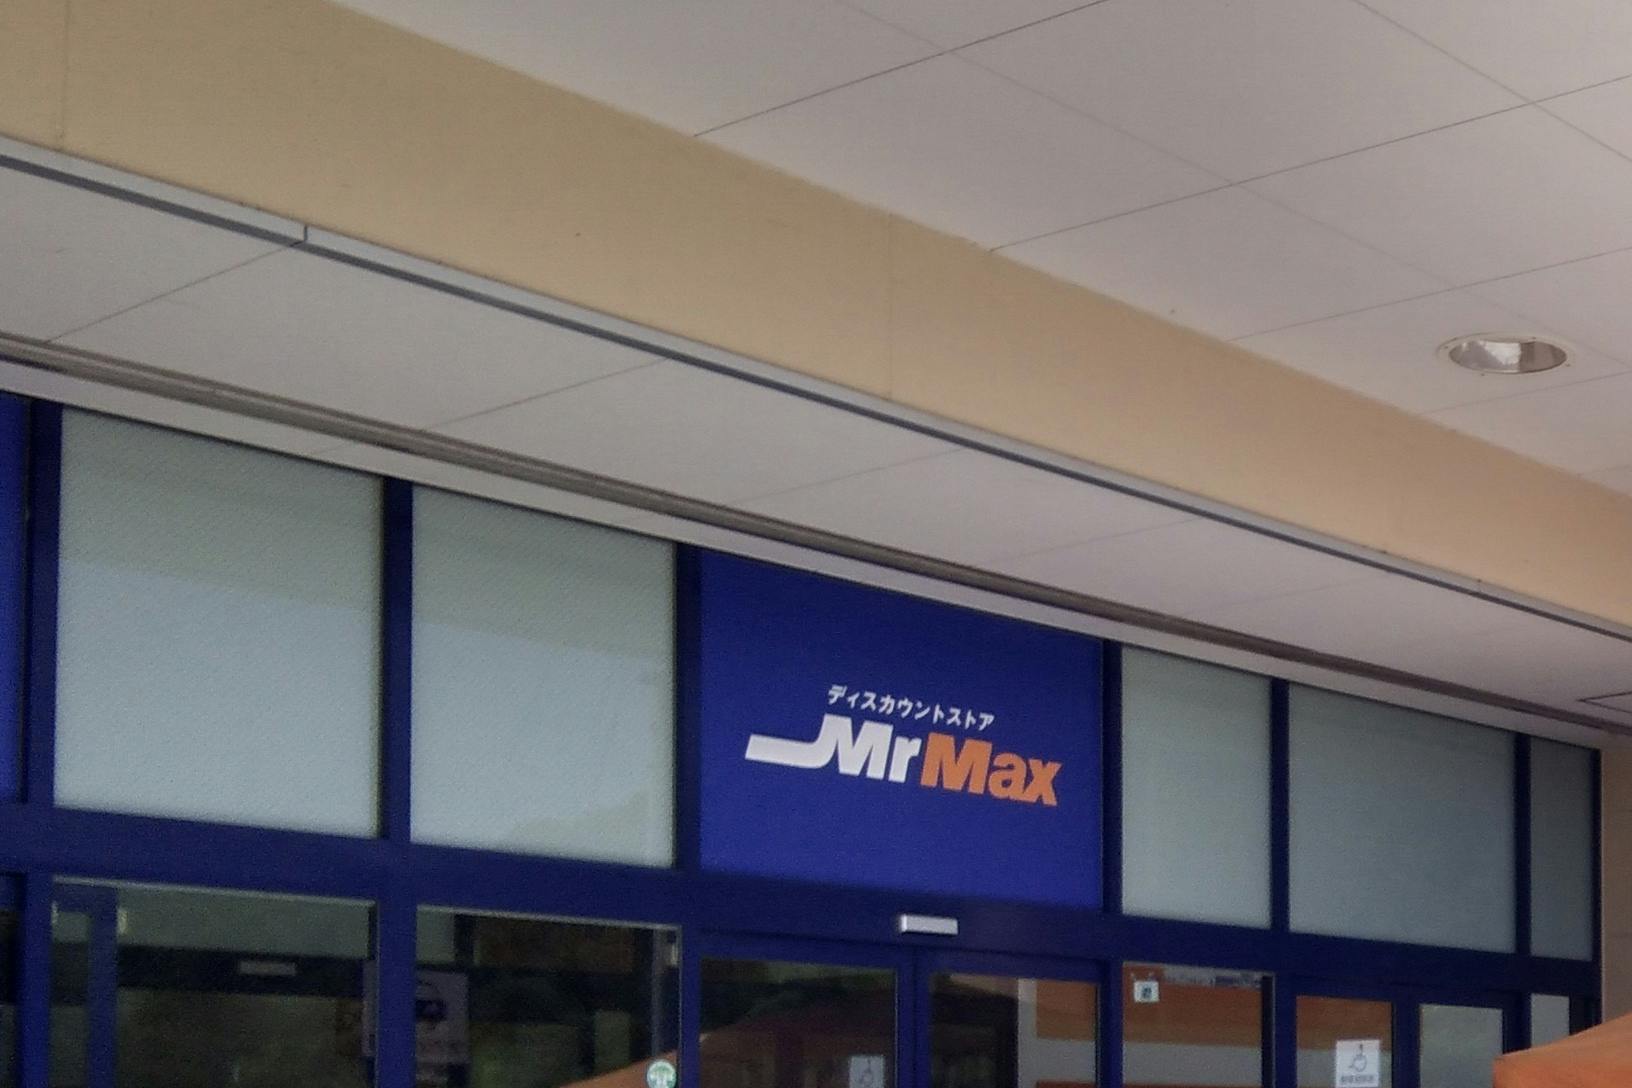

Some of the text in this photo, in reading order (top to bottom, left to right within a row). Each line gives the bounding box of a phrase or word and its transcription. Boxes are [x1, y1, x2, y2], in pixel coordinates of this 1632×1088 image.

[828, 683, 995, 731] ディスカウントストア
[745, 712, 1063, 807] MrMax
